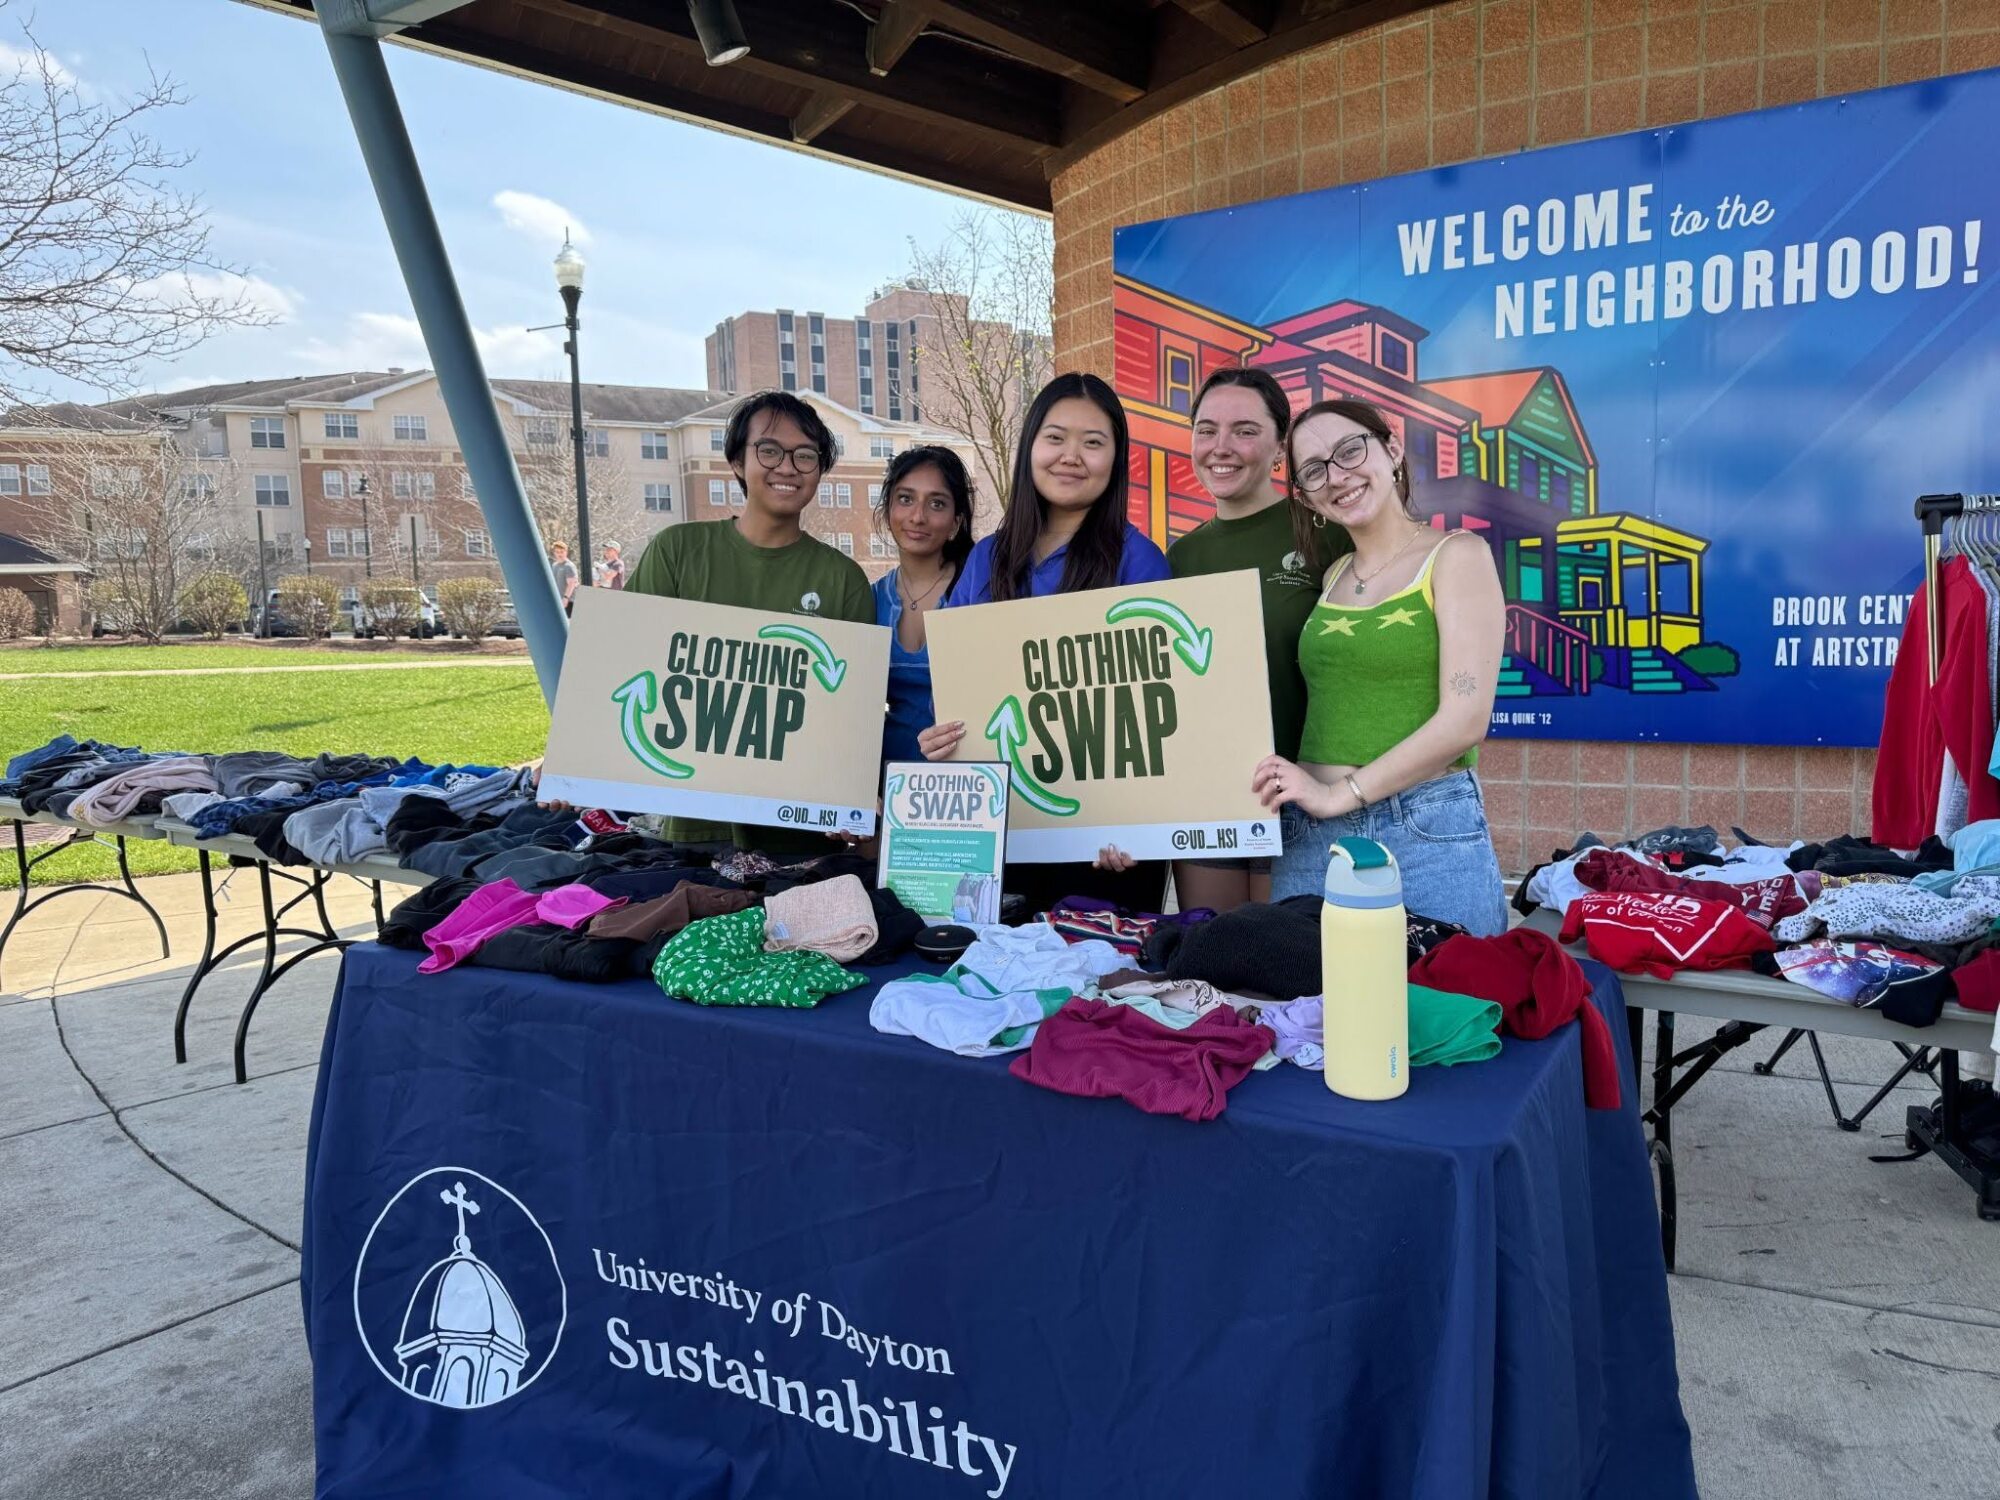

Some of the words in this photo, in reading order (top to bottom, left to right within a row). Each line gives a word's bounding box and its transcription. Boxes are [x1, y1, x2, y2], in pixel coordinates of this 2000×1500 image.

[1398, 183, 1653, 276] WELCOME
[1669, 203, 1710, 238] to
[1716, 194, 1776, 229] the
[1495, 220, 1982, 339] NEIGHBORHOOD!
[1773, 596, 1847, 626] BROOK
[667, 632, 809, 689] CLOTHING
[1022, 625, 1172, 692] CLOTHING
[1775, 637, 1801, 667] AT
[654, 674, 806, 761] SWAP
[1028, 682, 1178, 783] SWAP
[1492, 712, 1509, 724] LISA
[1512, 712, 1536, 726] QUINE
[908, 774, 985, 793] CLOTHING
[777, 805, 838, 827] @UD_HSI
[907, 791, 982, 821] SWAP
[1171, 828, 1238, 850] @UD_HSI
[1606, 902, 1624, 916] of
[592, 1248, 763, 1323] University
[771, 1293, 811, 1338] of
[820, 1300, 955, 1376] Dayton
[606, 1316, 1018, 1499] Sustainability
